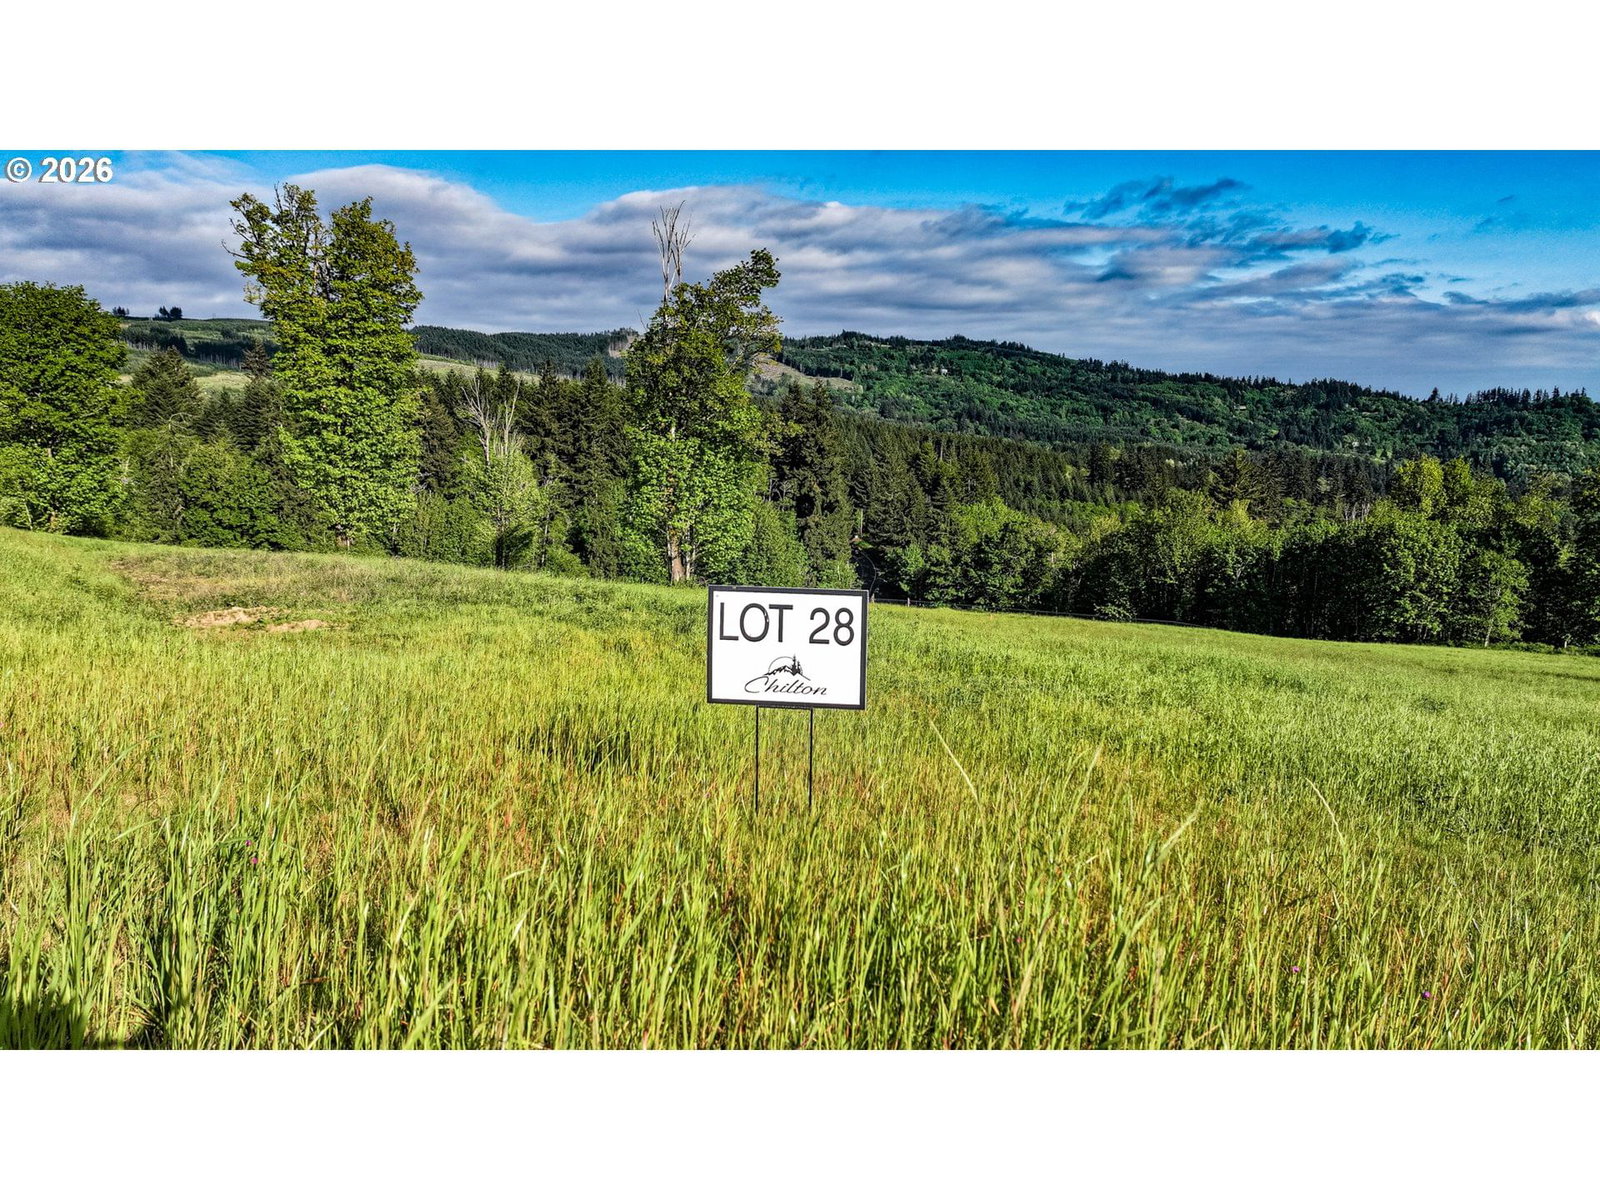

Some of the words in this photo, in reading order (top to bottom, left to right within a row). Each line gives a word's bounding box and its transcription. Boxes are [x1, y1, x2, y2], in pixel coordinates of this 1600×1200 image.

[719, 602, 794, 643] LOT
[808, 607, 855, 647] 28
[744, 675, 828, 696] Chilton
